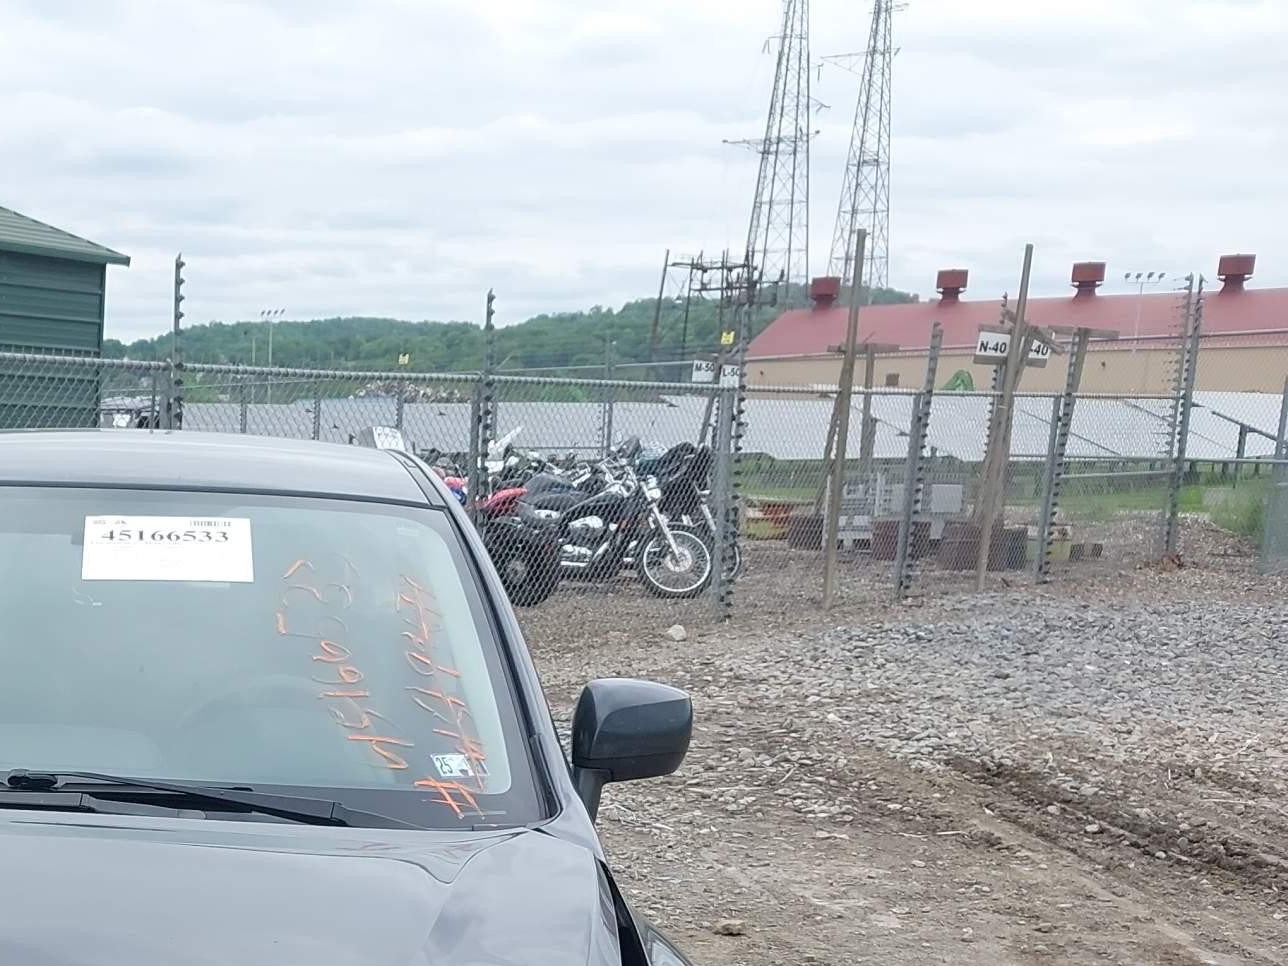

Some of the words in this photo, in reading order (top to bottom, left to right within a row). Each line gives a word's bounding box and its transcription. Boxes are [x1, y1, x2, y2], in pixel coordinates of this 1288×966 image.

[978, 340, 1007, 354] N-40
[1029, 343, 1049, 356] -40
[101, 529, 229, 543] 45166533
[435, 756, 453, 775] 25
